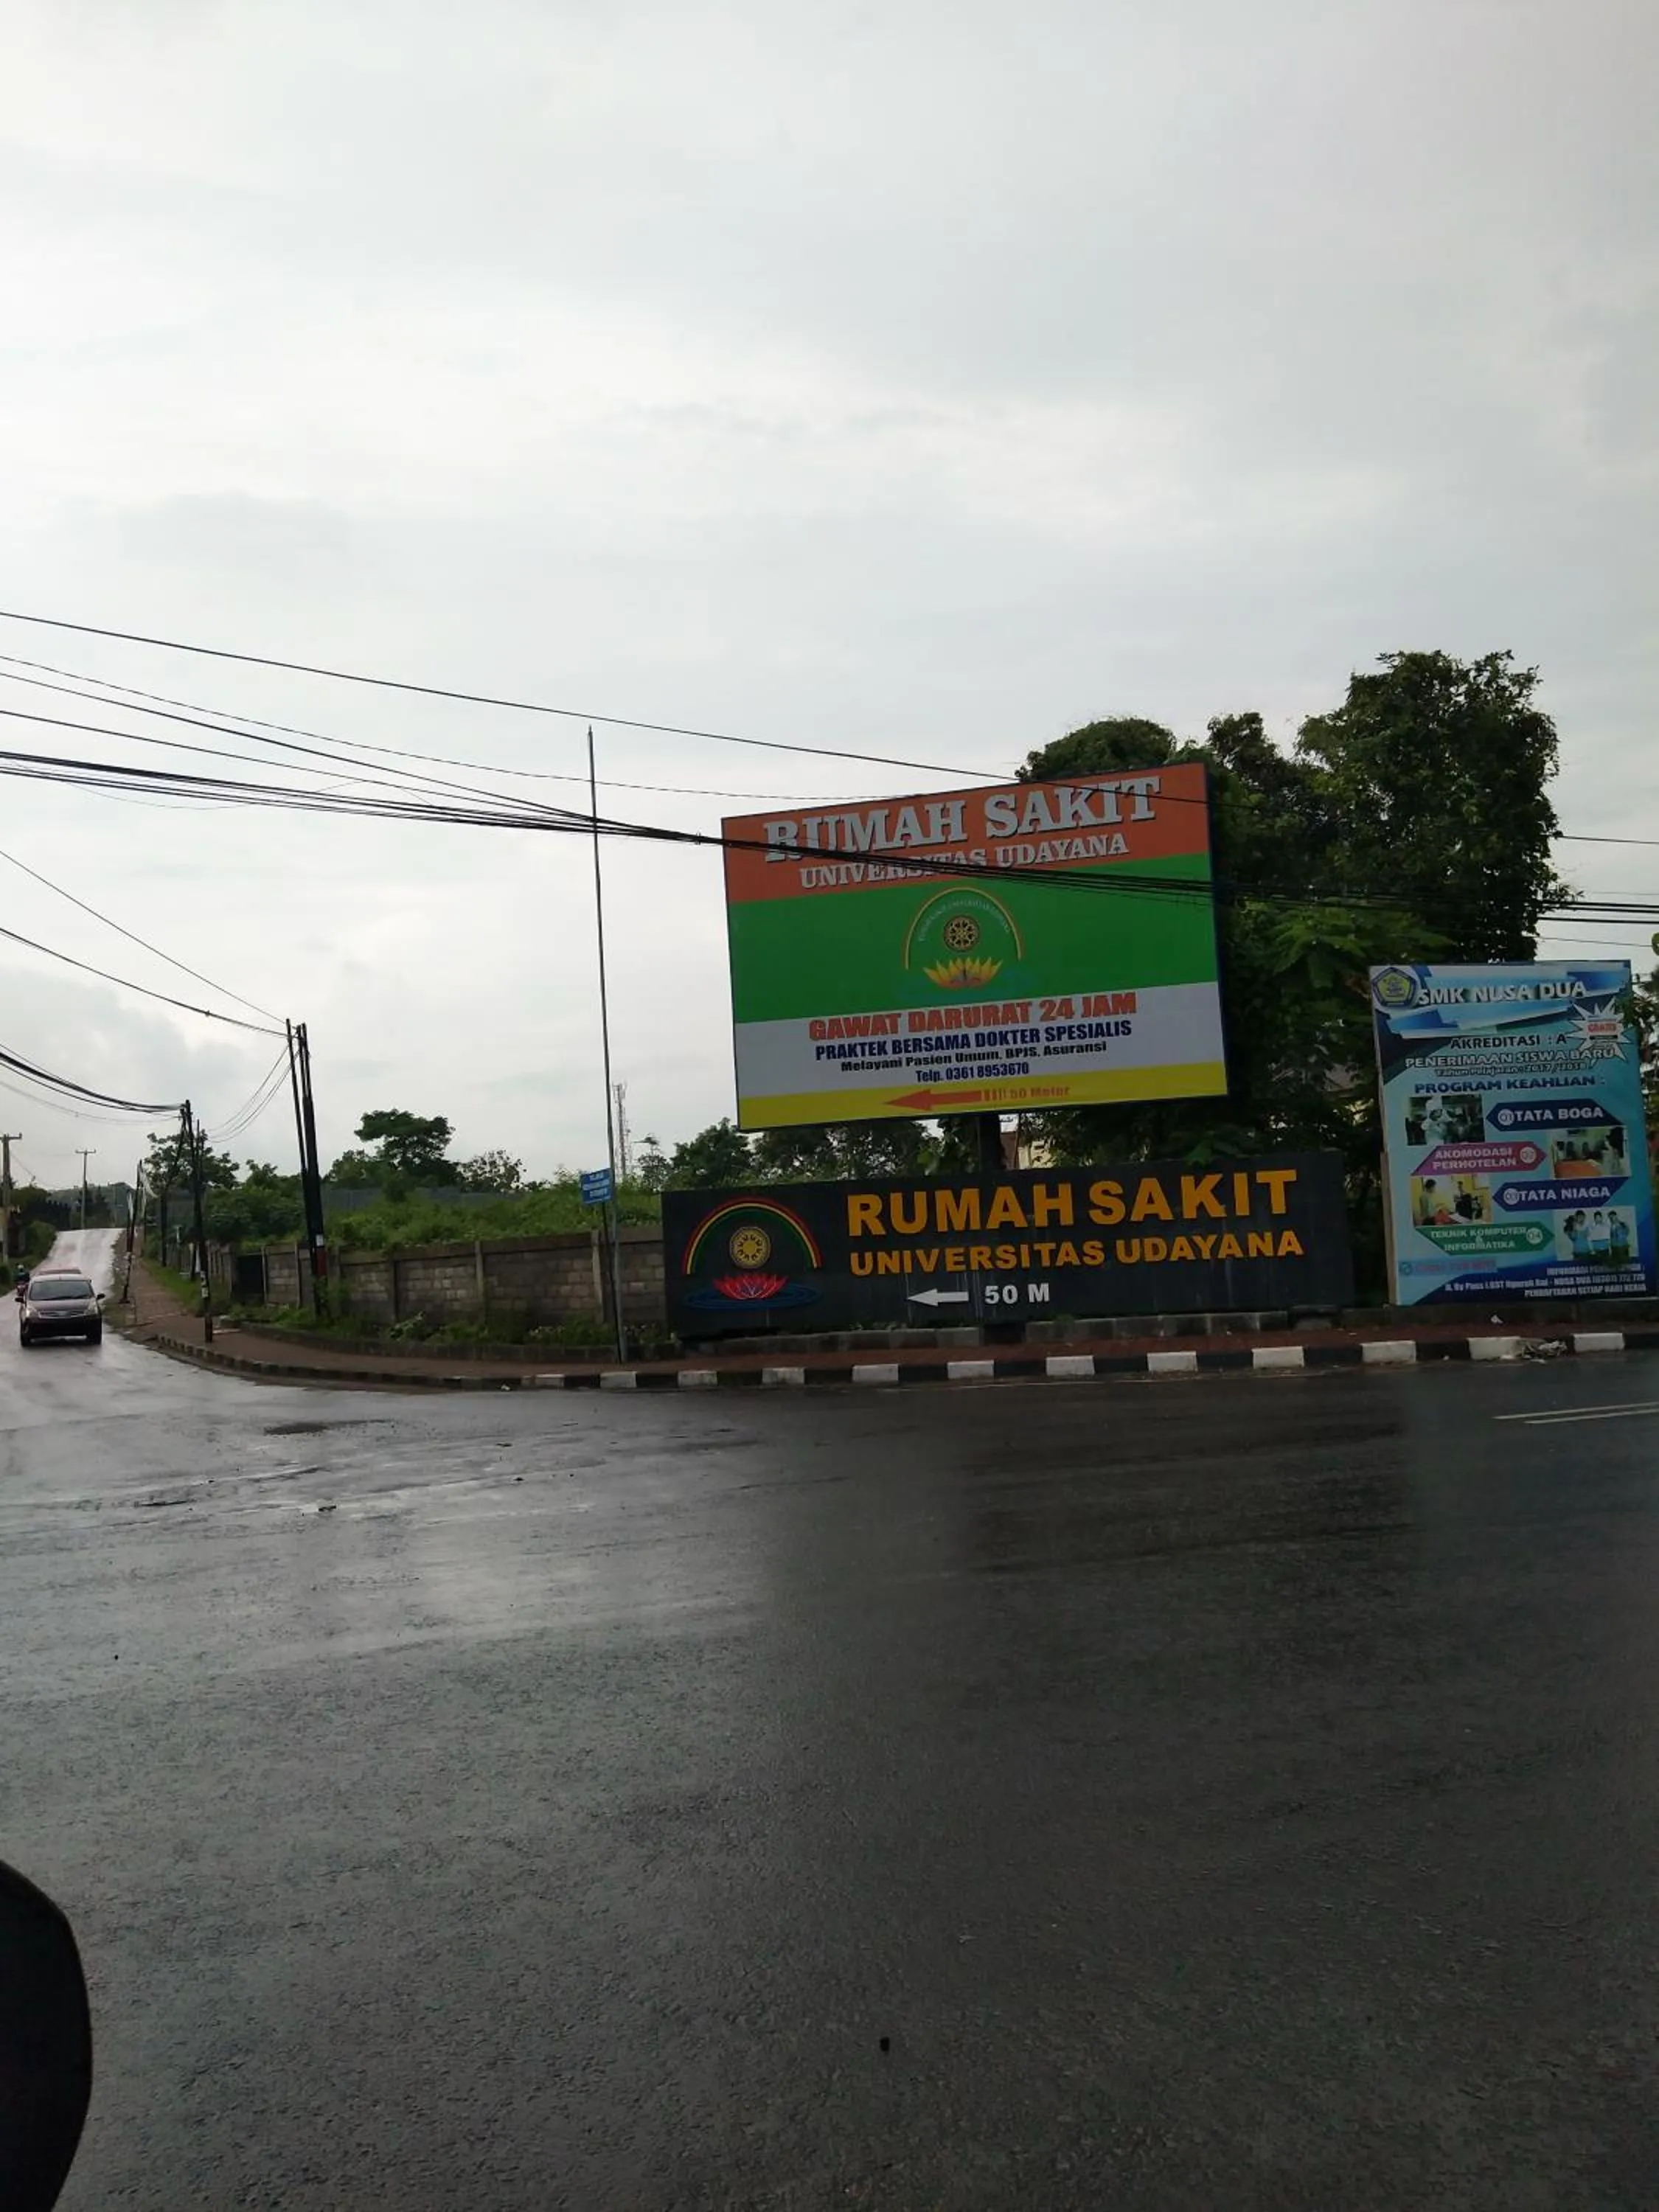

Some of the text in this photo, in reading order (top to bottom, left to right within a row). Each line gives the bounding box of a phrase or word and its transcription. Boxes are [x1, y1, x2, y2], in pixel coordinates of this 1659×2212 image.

[762, 776, 1161, 862] RUMAH SAKIT
[995, 833, 1130, 868] UDAYANA
[1417, 981, 1587, 1005] SMK NUSA DUA
[809, 991, 1136, 1041] GAWAT DARURAT 24 JAM
[815, 1020, 1132, 1060] PRAKTEK BERSAMA DOKTER SPESIALIS
[1450, 1034, 1541, 1049] AKREDITASI
[1556, 1034, 1568, 1045] A
[841, 1057, 903, 1072] Melayani
[905, 1054, 952, 1067] Pasien
[1043, 1040, 1107, 1057] Asuransi
[1405, 1052, 1514, 1068] PENERIMAAN
[1516, 1049, 1566, 1064] SISWA
[946, 1065, 975, 1080] 0361
[1414, 1079, 1502, 1094] PROGRAM
[1506, 1076, 1596, 1089] KEAHLIAN
[1515, 1108, 1554, 1122] TATA
[1558, 1107, 1604, 1120] BOGA
[1433, 1157, 1517, 1170] PERHOTELAN
[1435, 1147, 1512, 1160] AKOMODASI
[847, 1169, 1297, 1237] RUMAH SAKIT
[1519, 1189, 1557, 1202] TATA
[1561, 1186, 1611, 1200] NIAGA
[849, 1230, 1304, 1276] UNIVERSITAS UDAYANA
[984, 1282, 1050, 1304] 50 M
